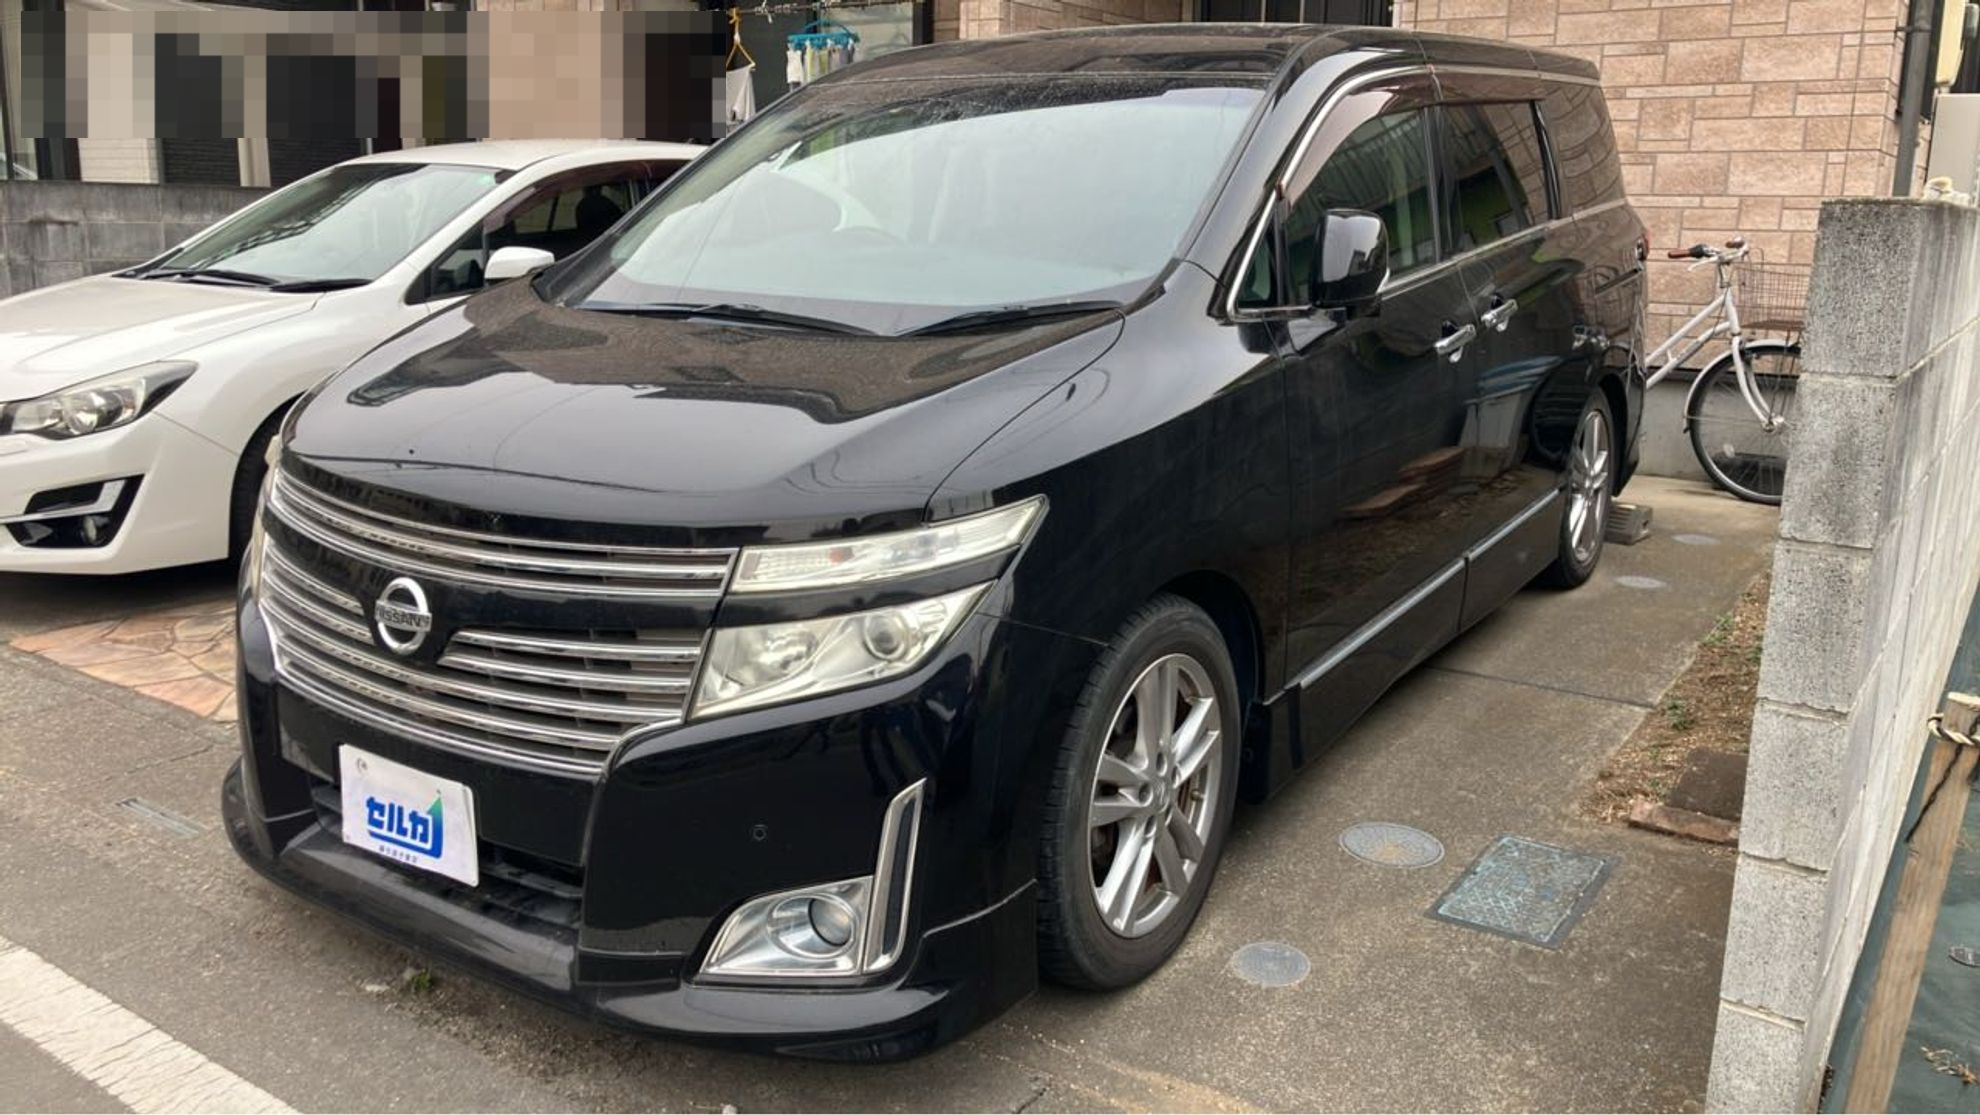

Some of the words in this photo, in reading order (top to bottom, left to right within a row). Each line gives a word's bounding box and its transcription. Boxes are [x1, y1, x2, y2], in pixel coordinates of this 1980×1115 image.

[376, 603, 424, 628] NISSAN
[365, 796, 430, 843] セルカ
